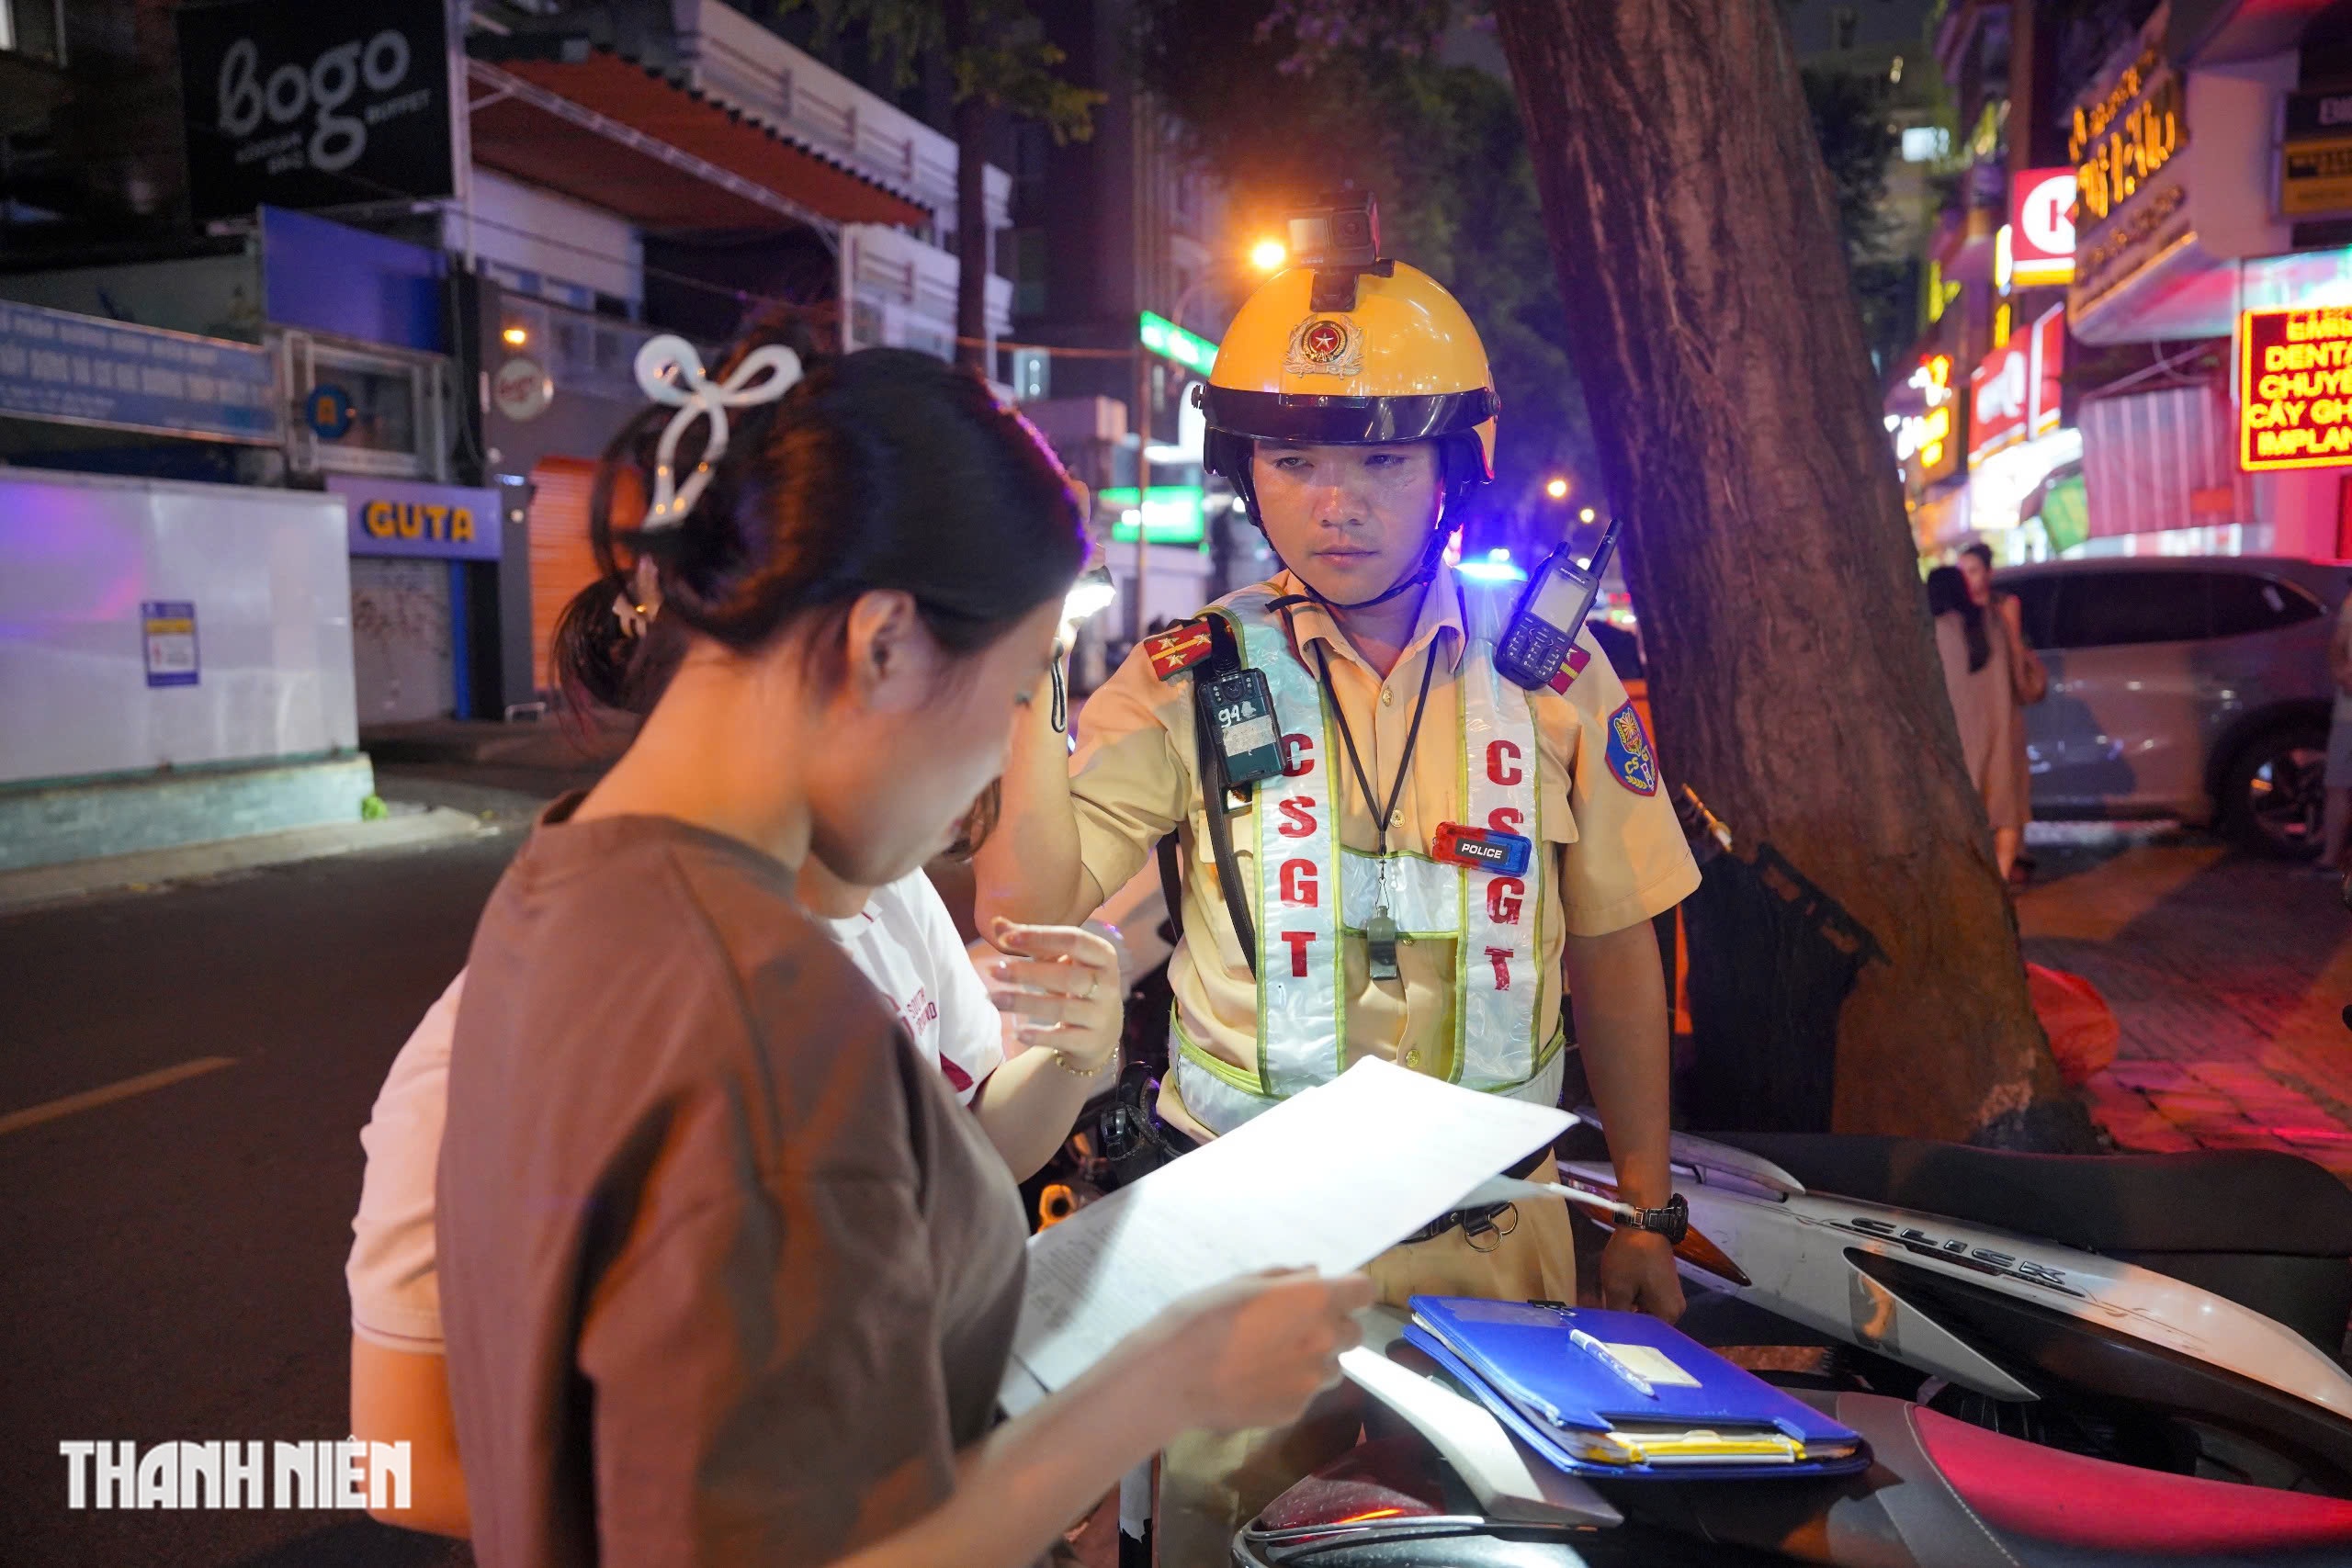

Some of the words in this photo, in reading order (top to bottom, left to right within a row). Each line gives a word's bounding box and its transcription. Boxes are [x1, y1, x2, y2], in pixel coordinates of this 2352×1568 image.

[219, 29, 411, 171] bogo
[366, 501, 475, 542] GUTA
[1461, 842, 1503, 860] POLICE
[1850, 1216, 2066, 1286] CLICK
